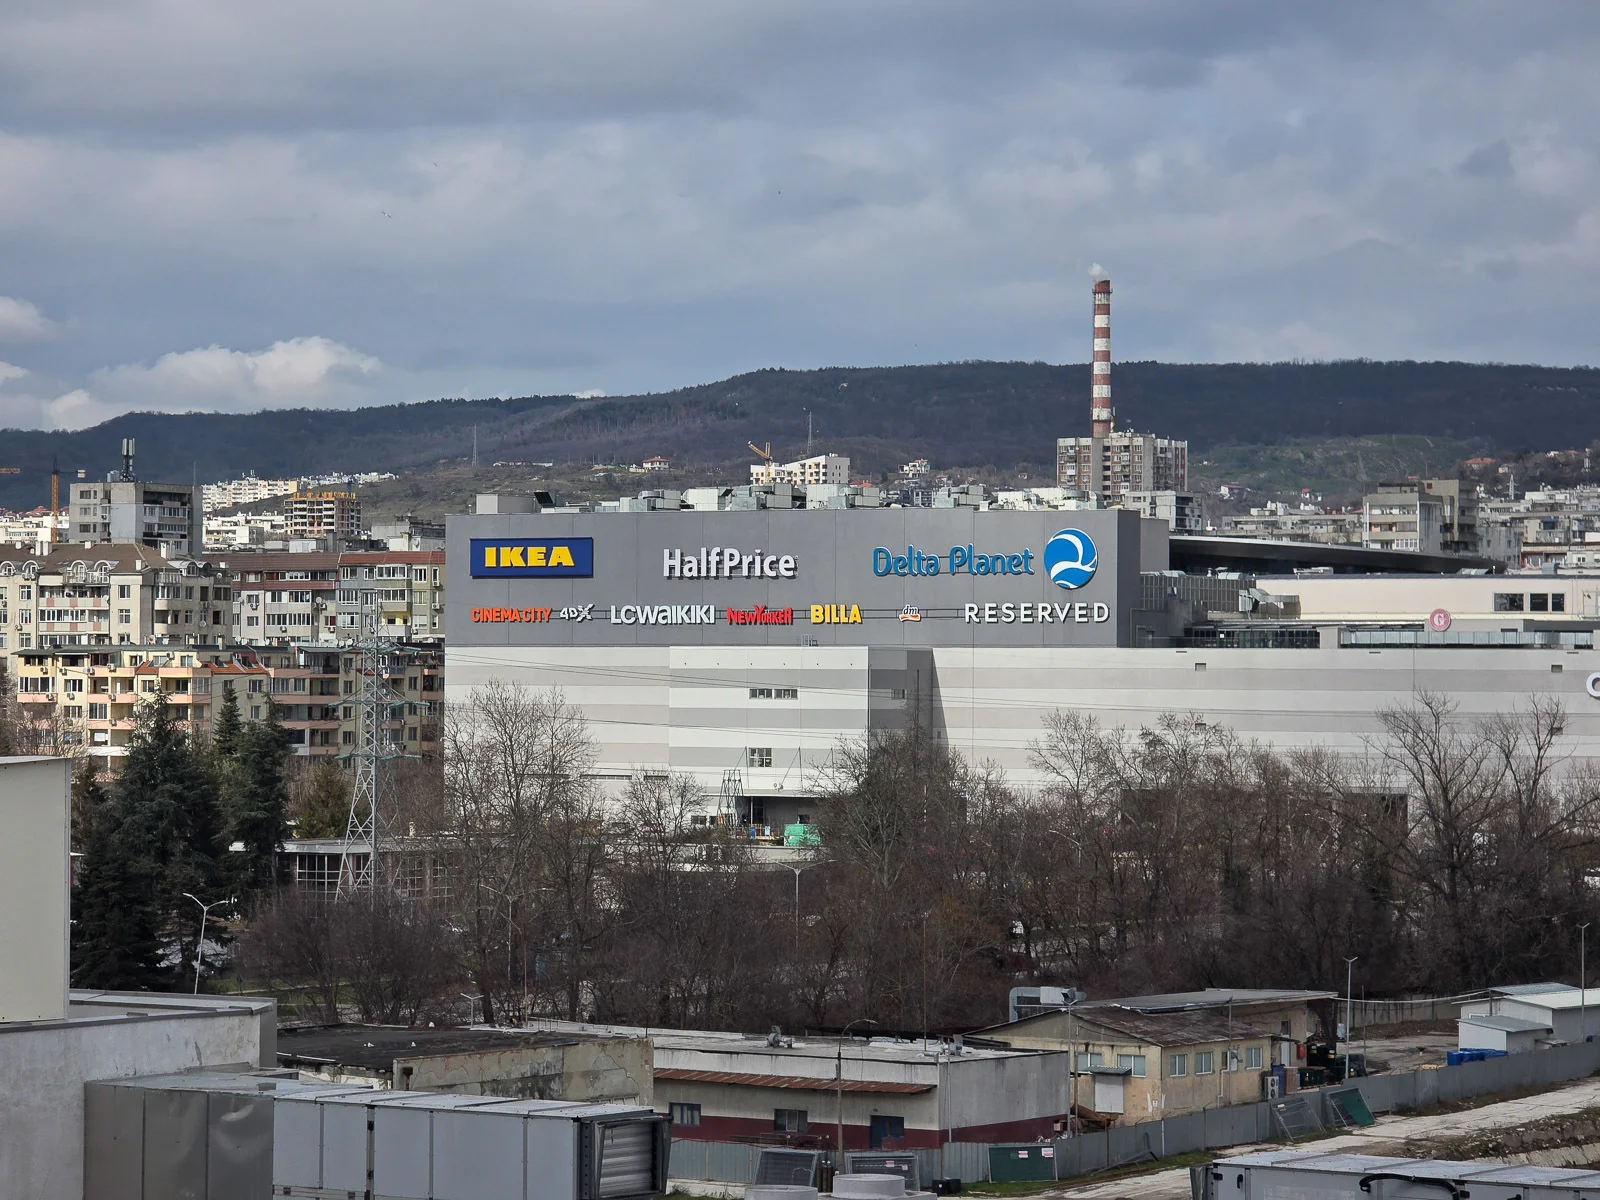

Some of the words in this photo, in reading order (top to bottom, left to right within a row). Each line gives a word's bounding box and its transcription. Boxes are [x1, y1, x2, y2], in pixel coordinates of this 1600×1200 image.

[484, 546, 575, 567] IKEA
[663, 547, 796, 577] HalfPrice
[873, 544, 939, 576] Delta
[950, 543, 1034, 575] Planet
[470, 607, 520, 622] CINEMA
[521, 607, 552, 622] CITY
[559, 603, 595, 622] 4DX
[810, 604, 863, 624] BILLA
[902, 604, 919, 615] dm
[964, 602, 1110, 623] RESERVED
